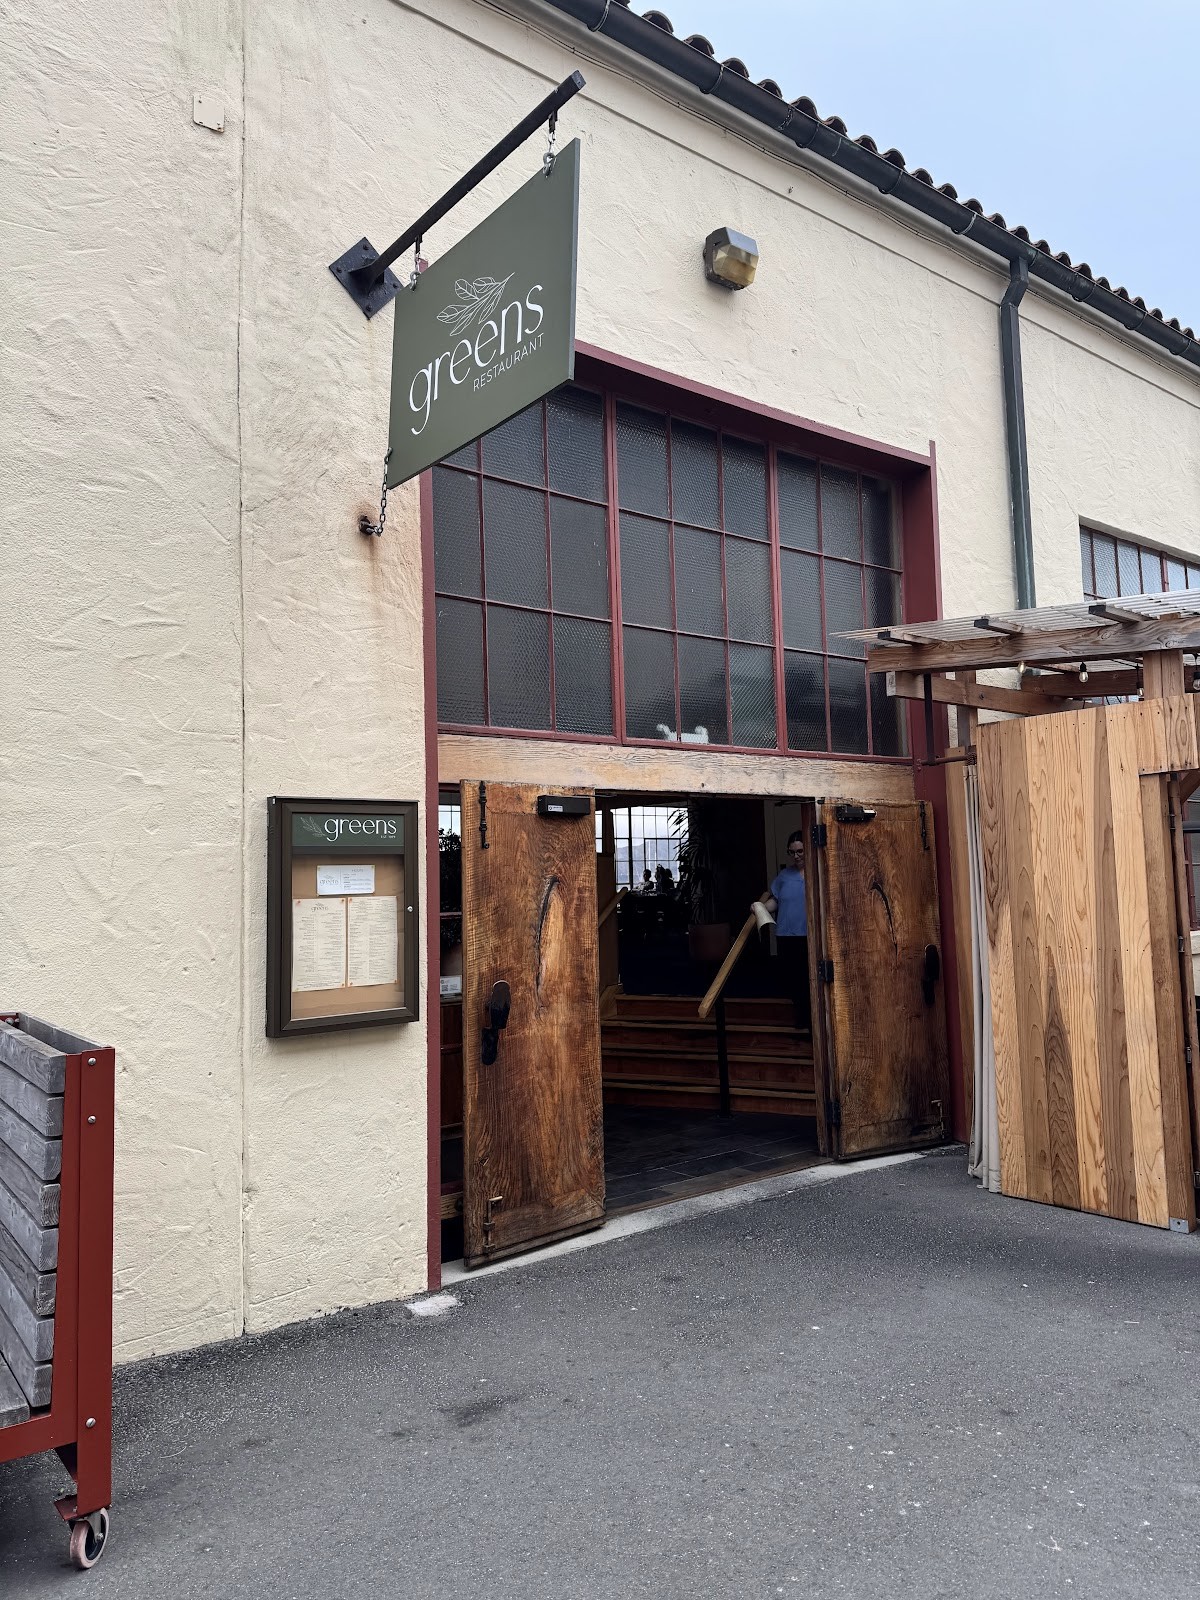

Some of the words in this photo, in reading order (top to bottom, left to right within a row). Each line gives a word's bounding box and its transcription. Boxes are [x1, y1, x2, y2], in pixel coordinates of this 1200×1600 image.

[409, 284, 544, 435] greens
[473, 332, 545, 392] RESTAURANT
[324, 818, 397, 842] greens
